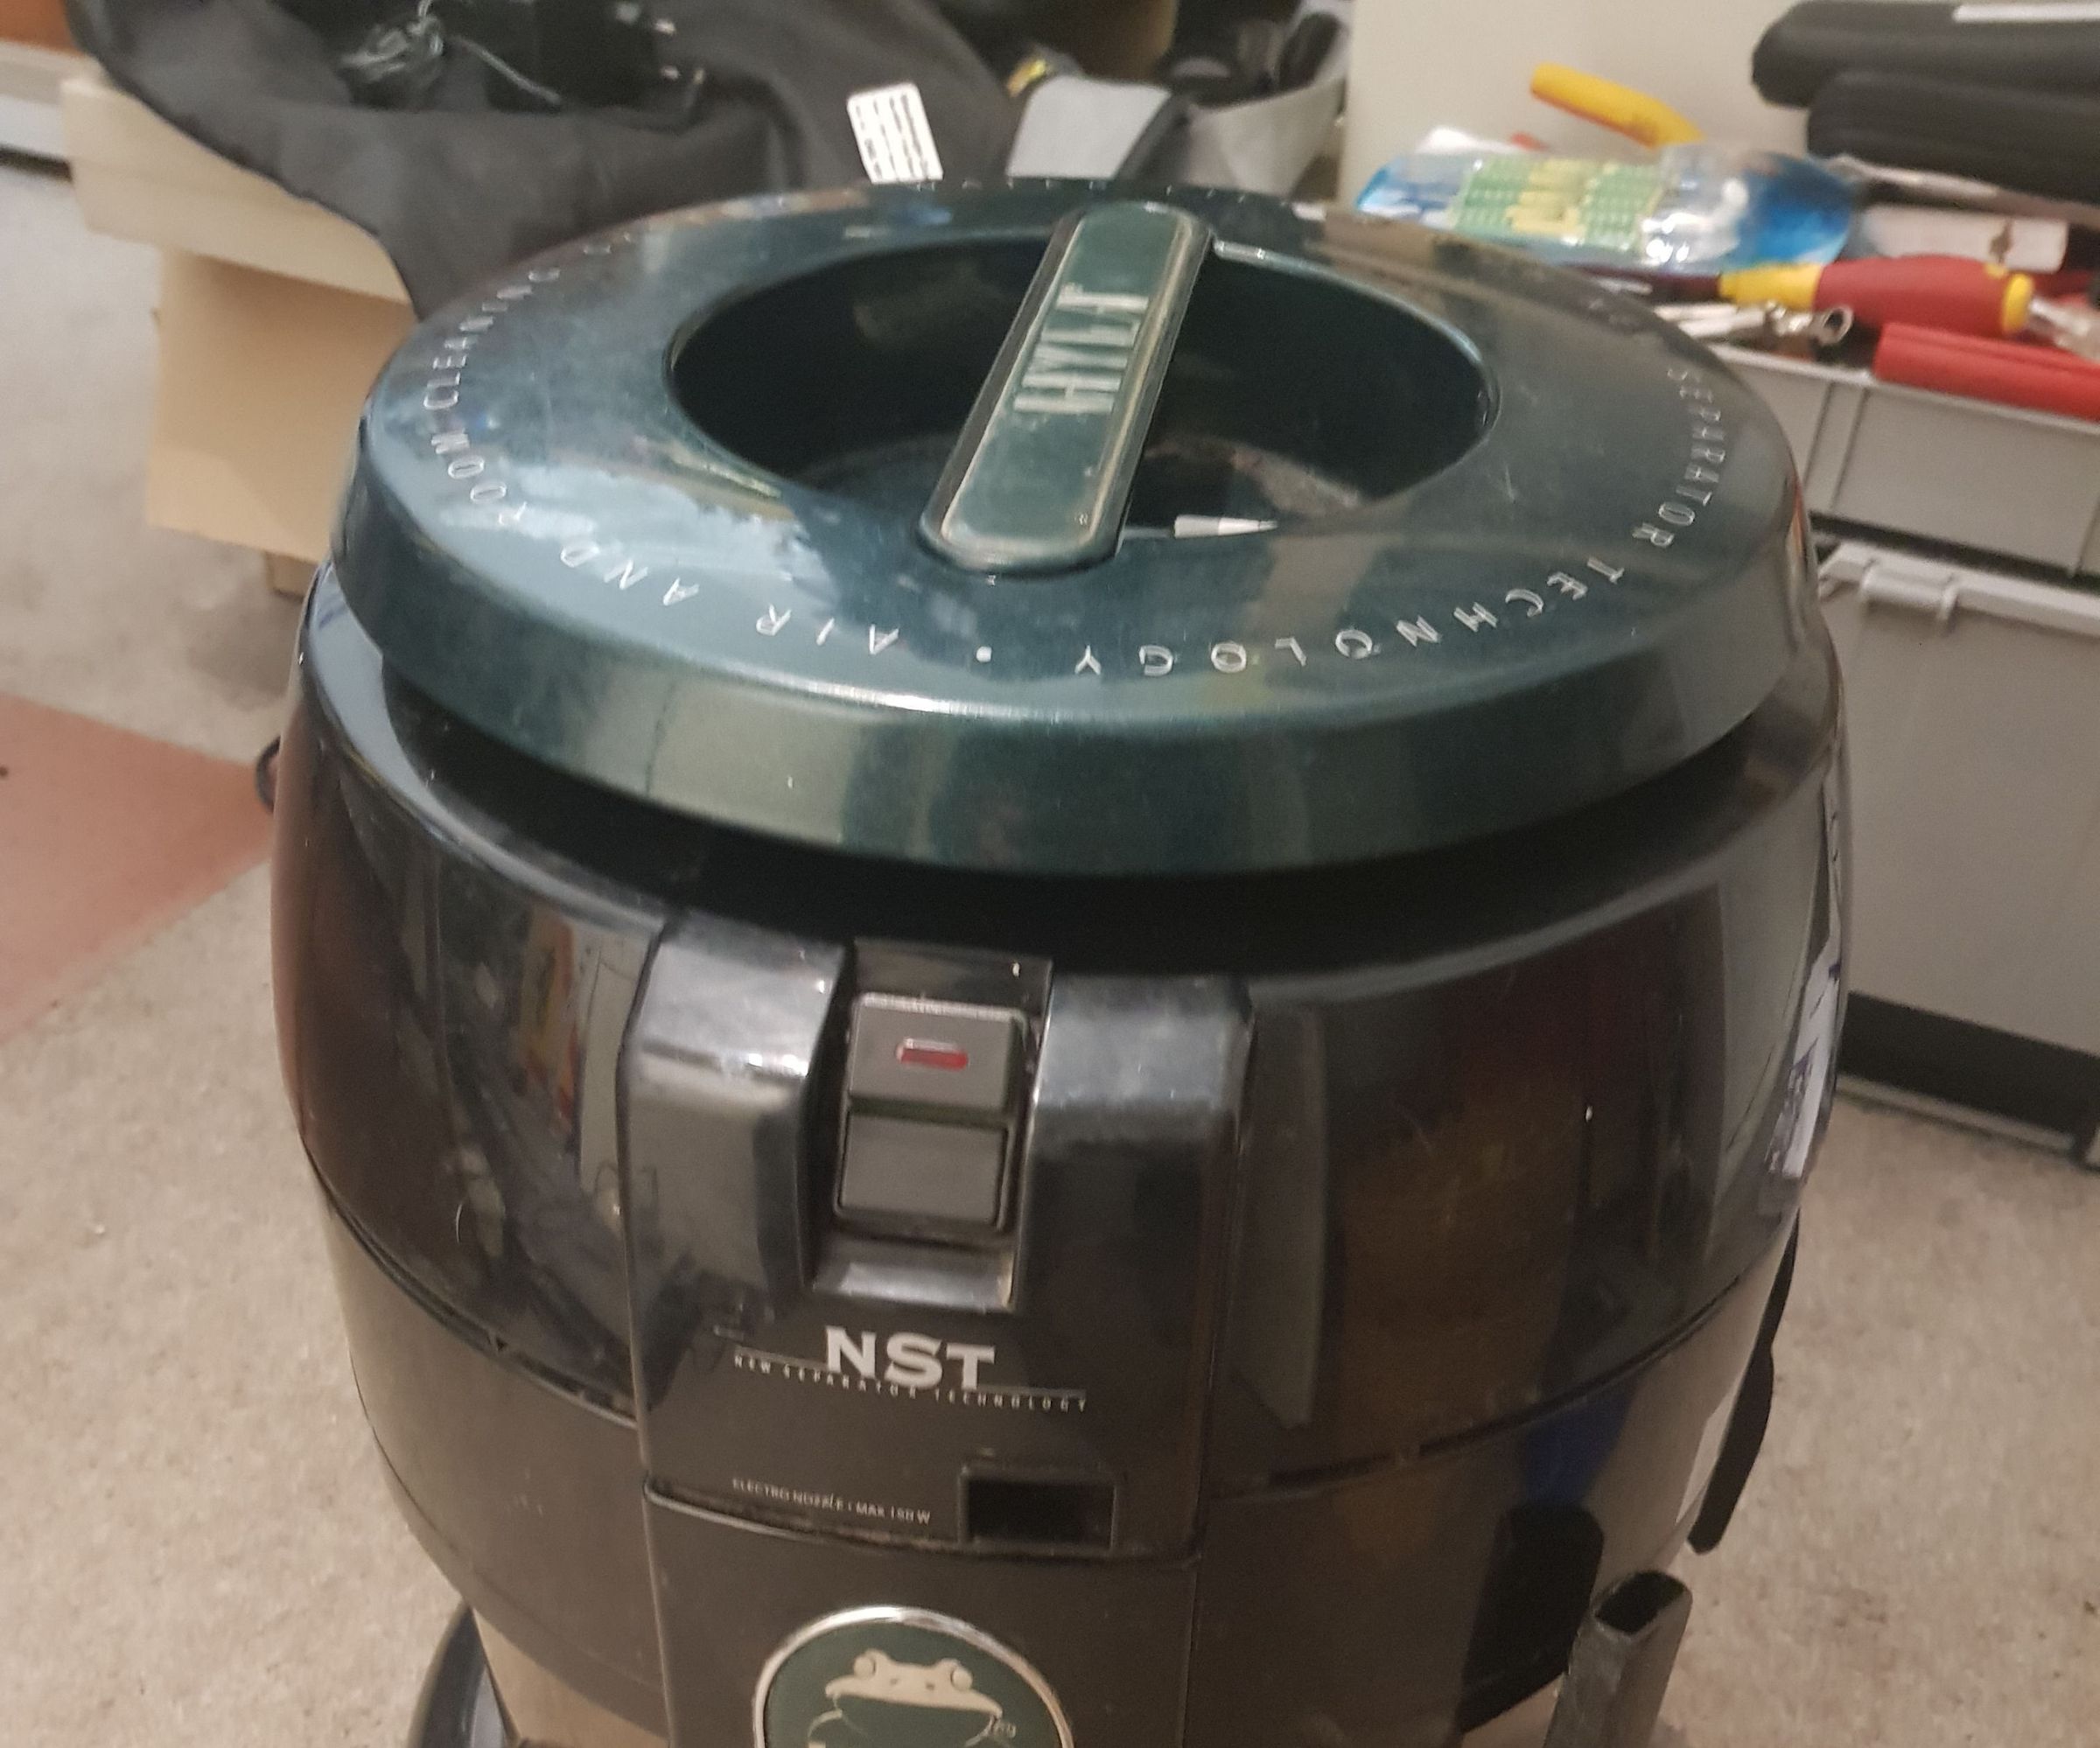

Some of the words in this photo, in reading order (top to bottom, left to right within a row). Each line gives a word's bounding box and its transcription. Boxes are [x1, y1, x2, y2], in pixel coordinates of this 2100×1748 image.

[560, 538, 700, 607] AND
[755, 603, 899, 655] AIR
[1073, 556, 1626, 679] TECHNOLOGY
[733, 1353, 772, 1374] NEW
[824, 1325, 996, 1391] NST
